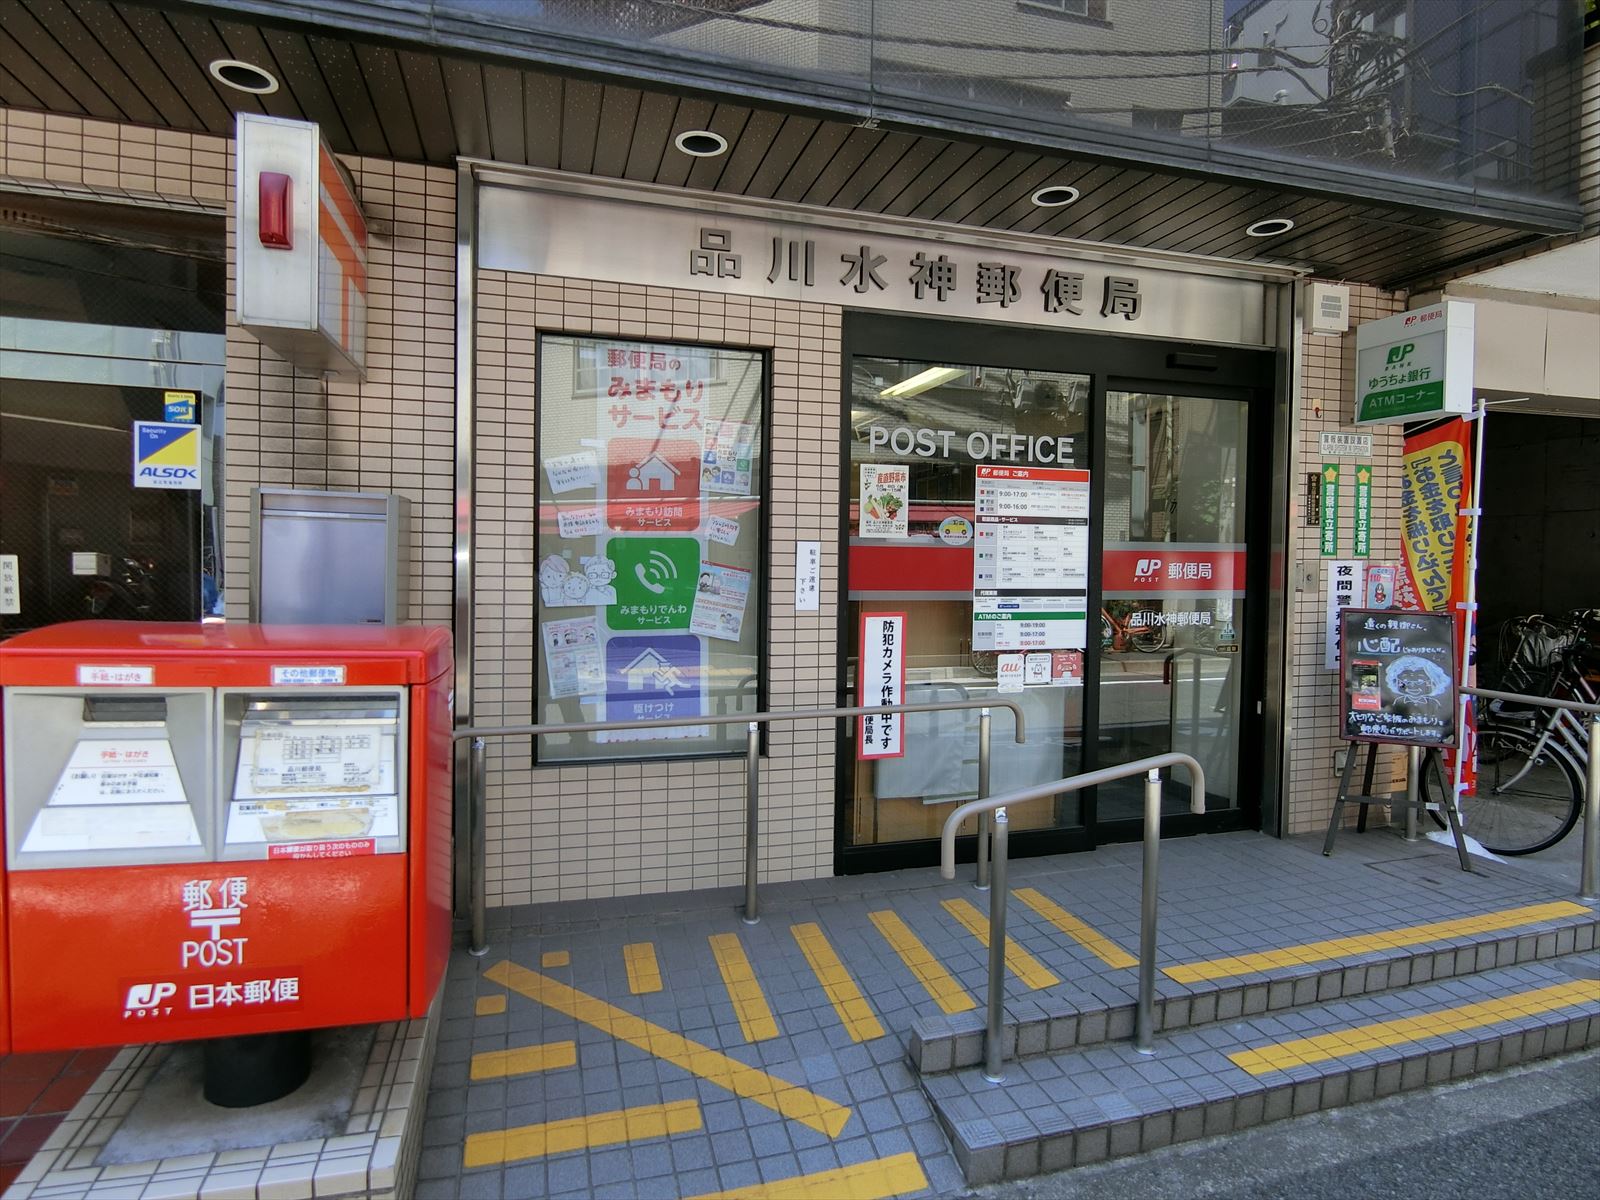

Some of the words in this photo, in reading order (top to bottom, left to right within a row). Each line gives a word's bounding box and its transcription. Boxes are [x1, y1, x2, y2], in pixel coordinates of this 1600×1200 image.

[691, 228, 1142, 320] 品川水神郵便局
[1420, 310, 1442, 323] 郵便局
[608, 349, 681, 371] 郵便局の
[1387, 343, 1415, 364] JP
[1368, 367, 1431, 390] ゆうちょ銀行
[608, 376, 703, 403] みまもり
[1369, 390, 1436, 408] ATMコーナー
[608, 404, 703, 430] サービス
[869, 426, 956, 458] POST
[966, 431, 1075, 464] OFFICE
[140, 467, 197, 479] ALSOK
[625, 507, 683, 517] みまもり訪問
[1324, 484, 1335, 553] 警察官立寄所
[1357, 485, 1368, 554] 警察官立寄所
[638, 518, 672, 527] サービス
[1135, 559, 1162, 576] JP
[1168, 562, 1212, 579] 郵便局
[620, 604, 687, 615] みまもりでんわ
[1131, 611, 1211, 627] 品川水神郵便局
[637, 616, 671, 625] サービス
[91, 672, 142, 681] 手紙・はがき
[282, 667, 336, 677] その他郵便物
[1001, 663, 1021, 673] au
[633, 702, 674, 714] 駆けつけ
[183, 877, 248, 911] 郵便
[182, 938, 248, 968] POST
[126, 982, 177, 1009] JP
[189, 977, 300, 1010] 日本郵便
[123, 1007, 173, 1018] POST
